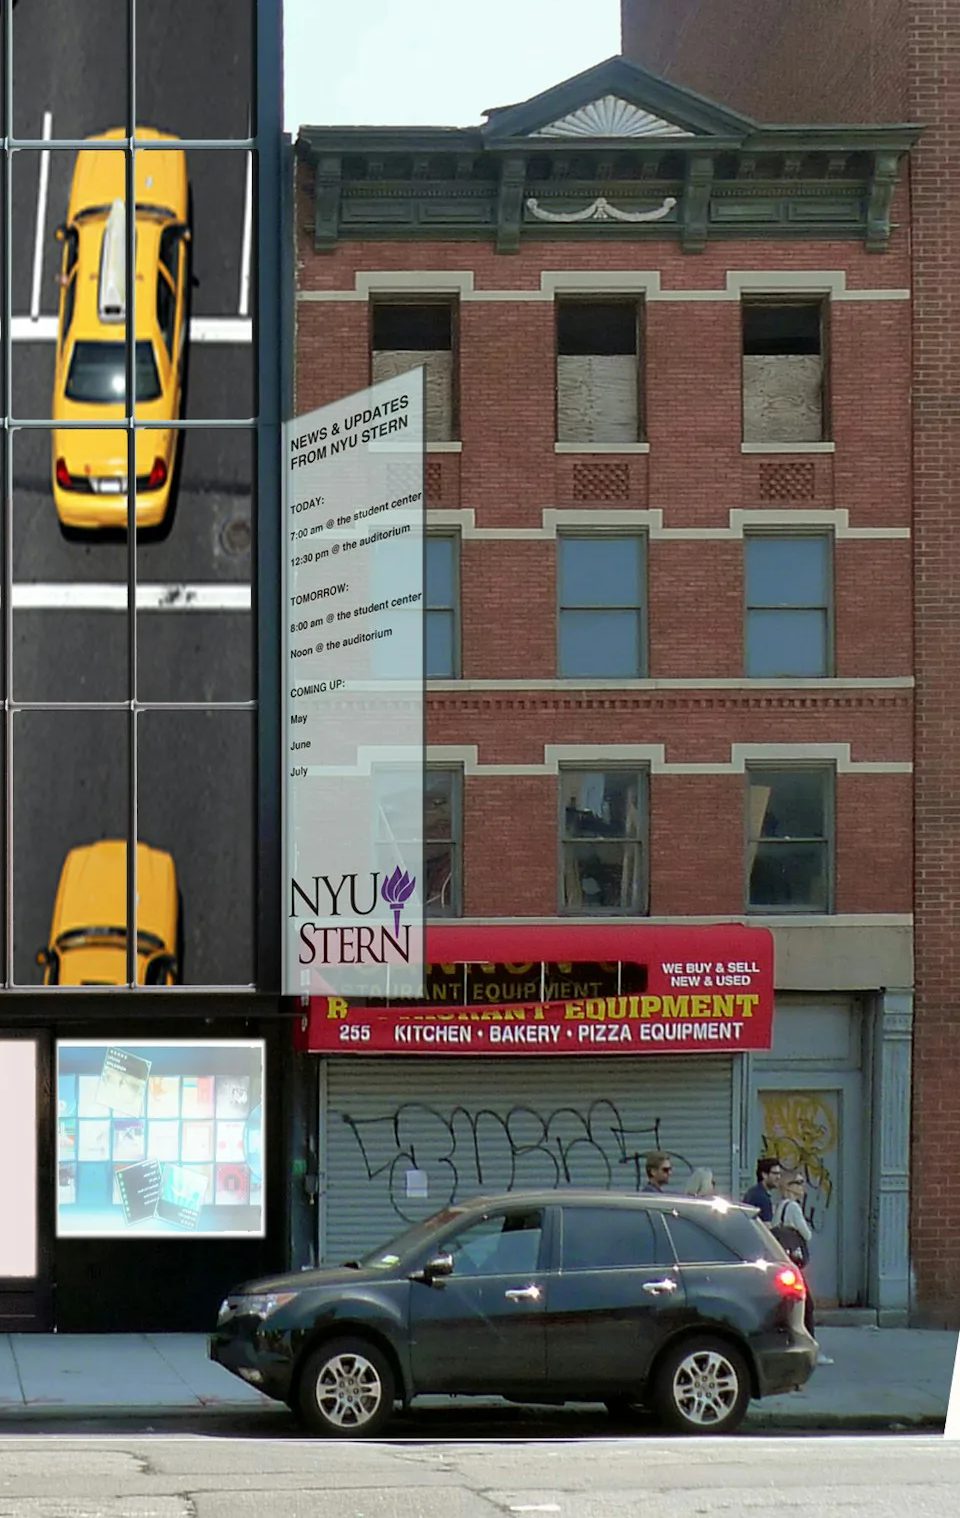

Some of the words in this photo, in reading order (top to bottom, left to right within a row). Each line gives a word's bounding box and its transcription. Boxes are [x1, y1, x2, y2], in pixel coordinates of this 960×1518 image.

[291, 427, 327, 451] NEWS
[331, 423, 340, 436] &
[345, 395, 408, 430] UPDATES
[292, 446, 326, 470] FROM
[331, 434, 357, 455] NYU
[362, 414, 408, 443] STERN
[291, 496, 324, 514] TODAY:
[291, 528, 308, 540] 7:00
[310, 525, 323, 534] am
[326, 519, 334, 529] @
[337, 516, 351, 526] the
[354, 502, 389, 520] student
[391, 493, 422, 508] center
[291, 553, 313, 566] 12:30
[316, 550, 328, 562] pm
[332, 544, 340, 554] @
[343, 541, 357, 551] the
[360, 525, 410, 546] auditorium
[291, 583, 348, 606] TOMORROW:
[291, 621, 308, 632] 8:00
[310, 618, 323, 628] am
[326, 614, 334, 623] @
[337, 611, 351, 620] the
[354, 600, 388, 616] student
[391, 593, 422, 607] center
[291, 648, 312, 658] Noon
[316, 643, 324, 652] @
[326, 641, 340, 650] the
[342, 628, 392, 646] auditorium
[291, 682, 326, 698] COMING
[330, 679, 344, 690] UP:
[291, 715, 307, 724] May
[291, 741, 311, 750] June
[291, 767, 308, 777] July
[289, 872, 380, 918] NYU
[299, 922, 412, 965] STERN
[662, 963, 682, 974] WE
[686, 963, 712, 974] BUY
[715, 963, 724, 973] &
[727, 962, 760, 973] SELL
[473, 982, 603, 1001] EQUIPMENT
[671, 976, 700, 987] NEW
[703, 976, 713, 986] &
[716, 975, 751, 986] USED
[564, 994, 759, 1021] EQUIPMENT
[340, 1024, 371, 1041] 255
[394, 1024, 472, 1042] KITCHEN
[490, 1024, 560, 1042] BAKERY
[578, 1024, 632, 1043] PIZZA
[640, 1022, 743, 1041] EQUIPMENT
